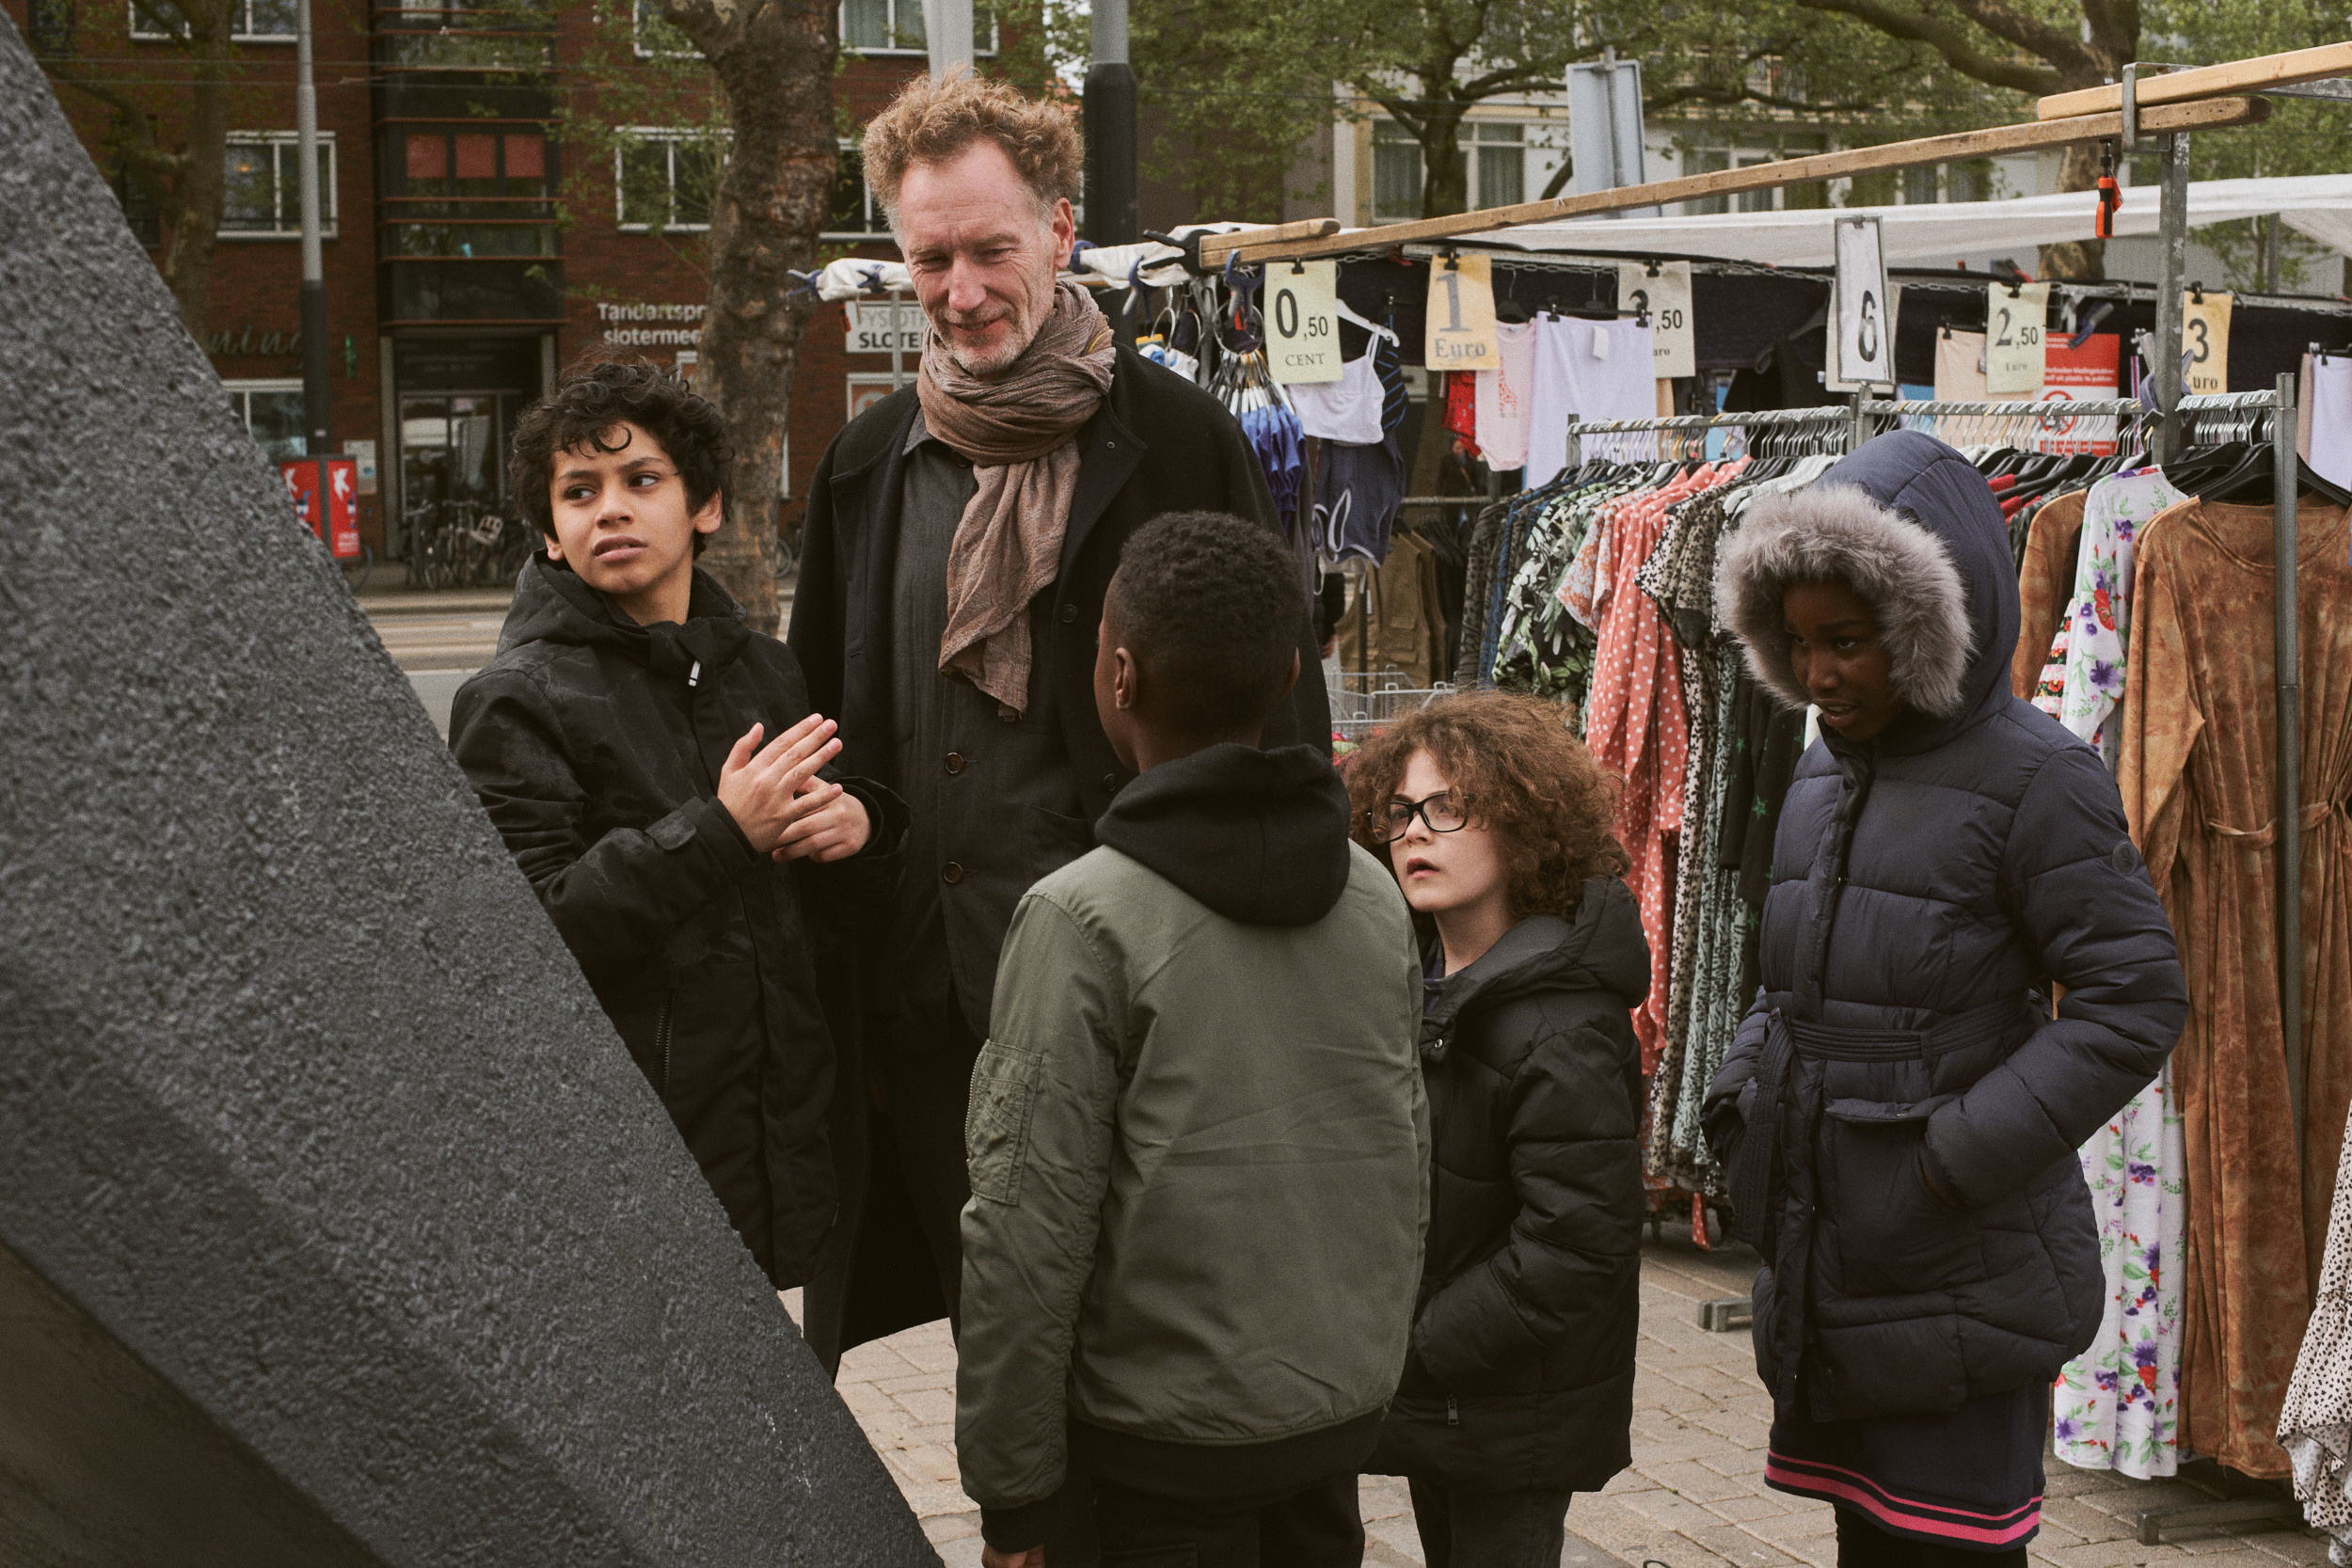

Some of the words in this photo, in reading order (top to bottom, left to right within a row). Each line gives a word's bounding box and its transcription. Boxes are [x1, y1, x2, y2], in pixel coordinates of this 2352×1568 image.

[1276, 288, 1328, 341] 0,50
[1437, 272, 1474, 332] 1
[859, 332, 924, 348] SLOTE
[1858, 290, 1878, 362] 6
[1995, 307, 2039, 349] 2,50
[2188, 318, 2209, 363] 3
[1285, 353, 1325, 366] CENT
[1435, 339, 1487, 358] Euro
[2187, 376, 2217, 389] uro
